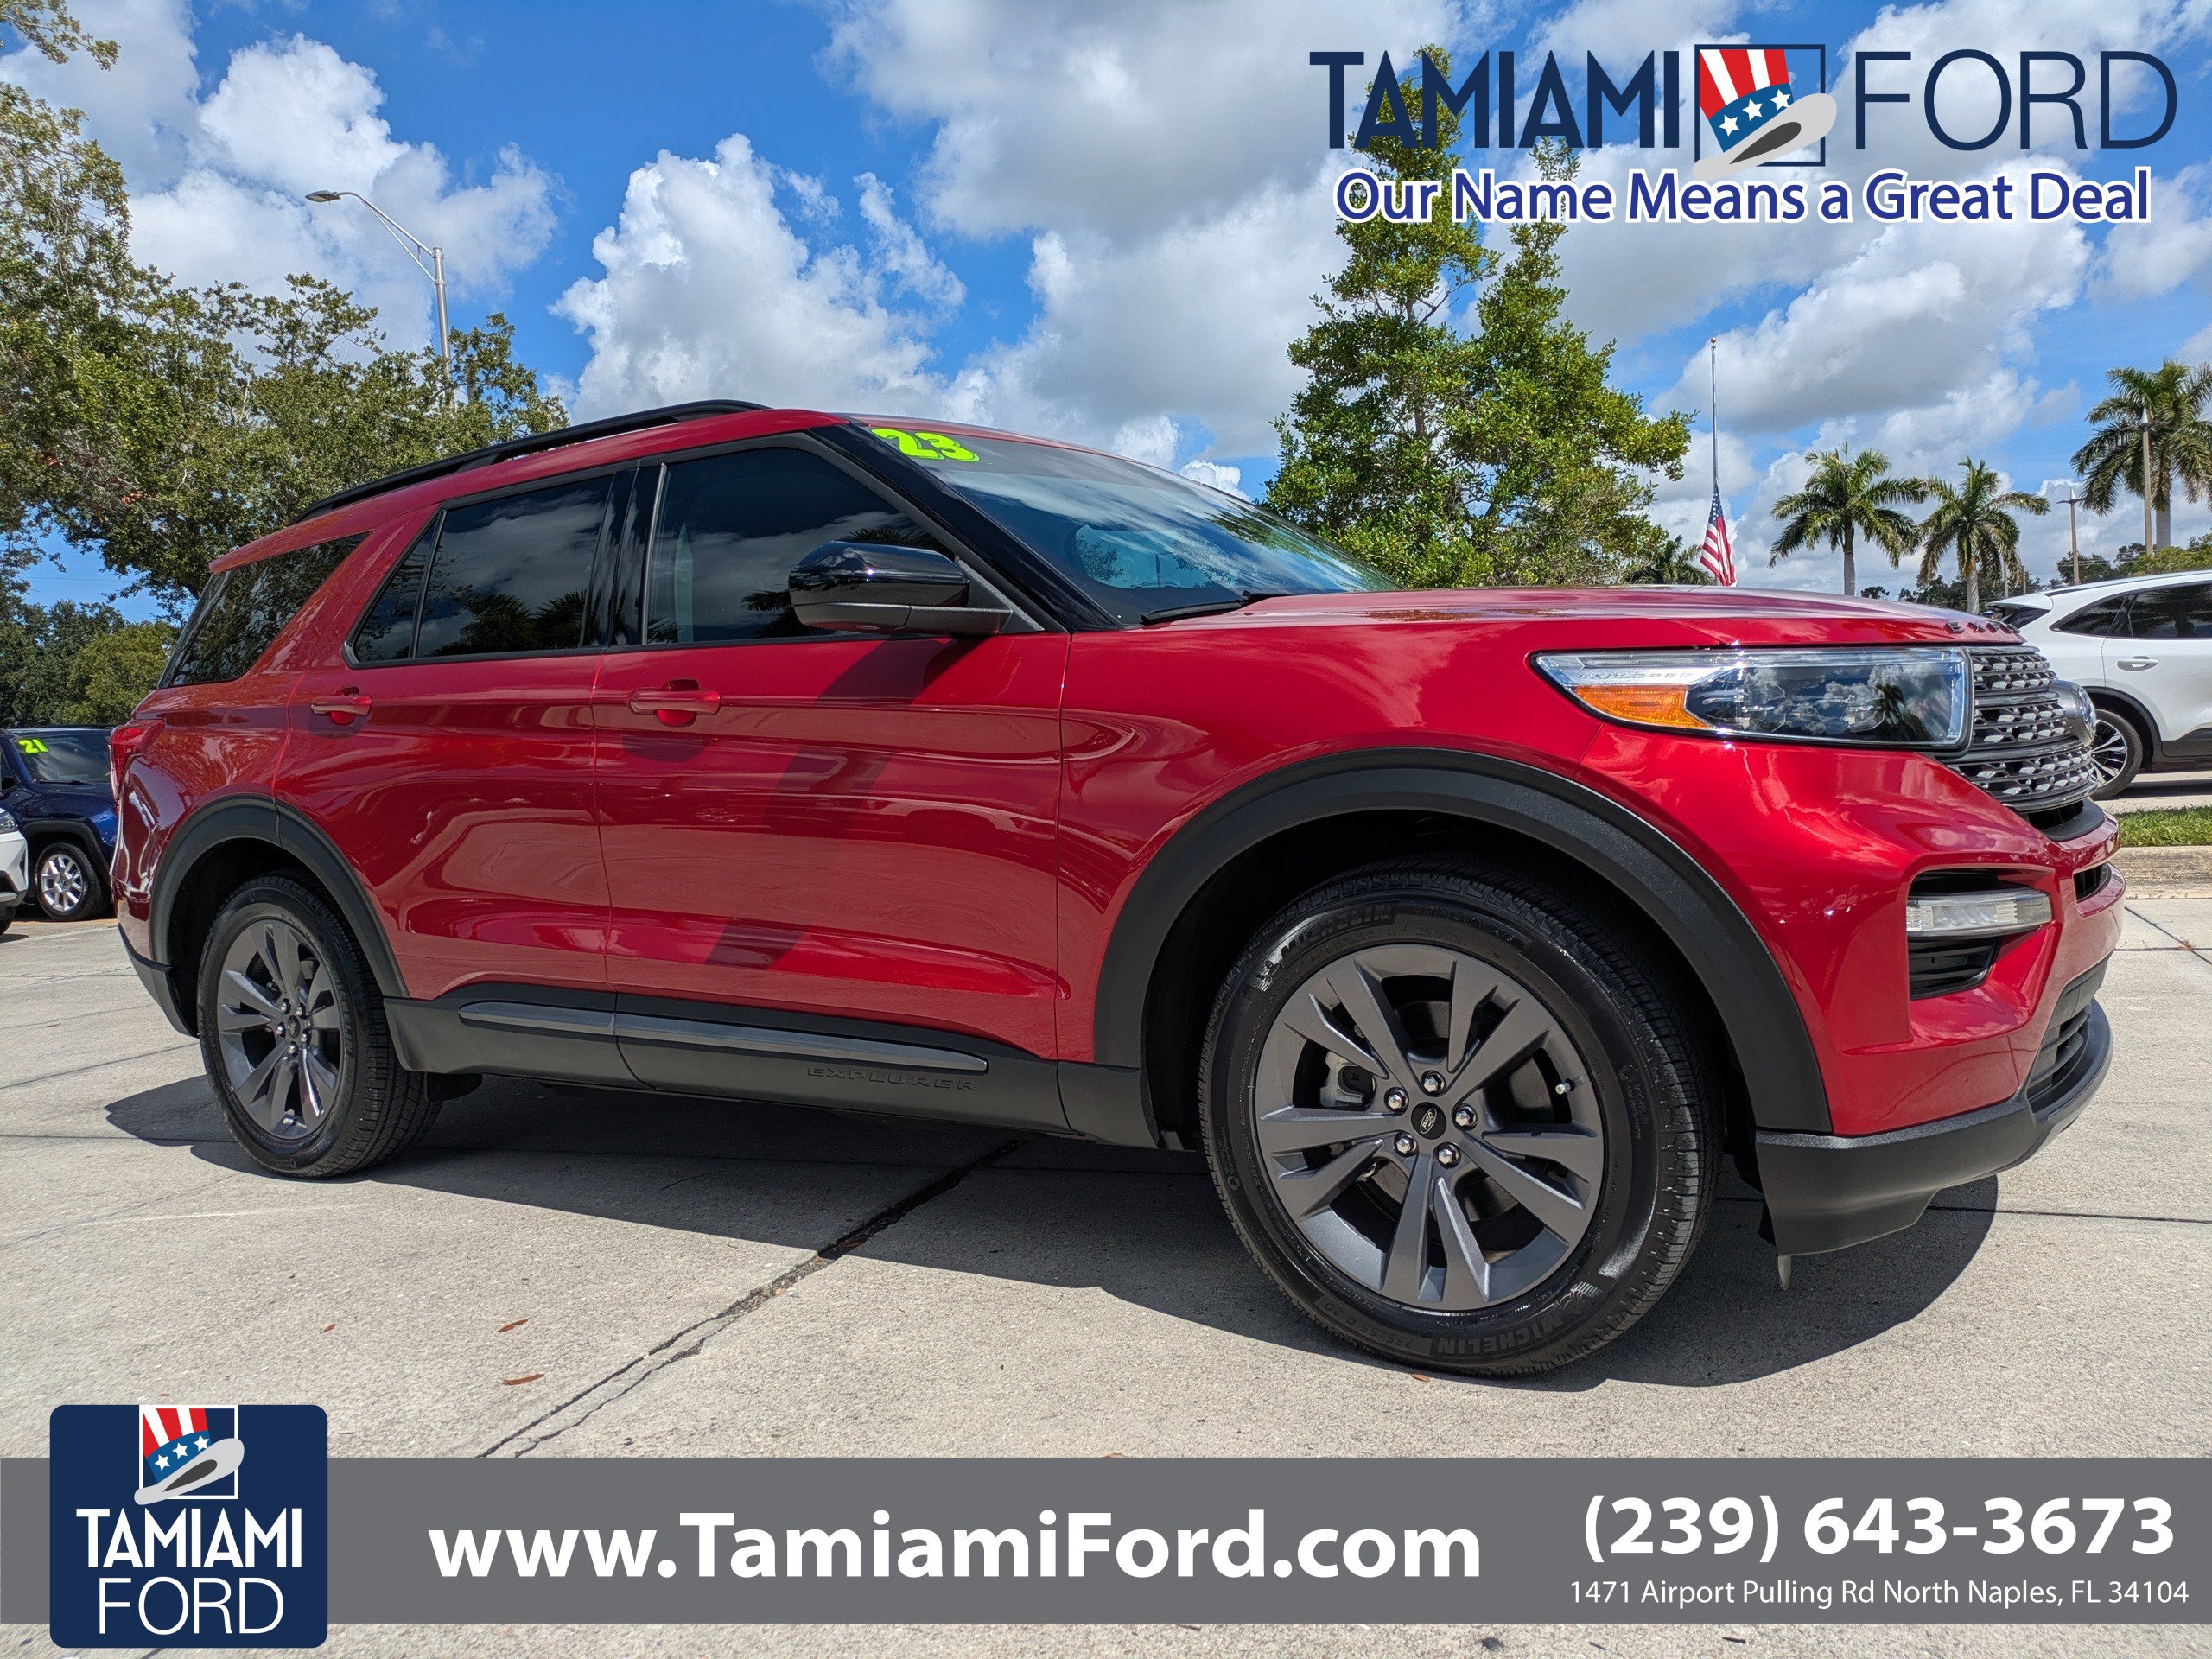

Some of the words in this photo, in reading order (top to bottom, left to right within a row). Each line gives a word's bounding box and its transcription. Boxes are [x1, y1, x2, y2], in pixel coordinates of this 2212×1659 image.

[872, 429, 980, 463] 23
[18, 739, 48, 753] 21
[1279, 906, 1394, 959] MICHELIN
[807, 1065, 977, 1091] EXPLORER
[1422, 1111, 1434, 1130] Ford
[1436, 1312, 1564, 1353] MICHELIN
